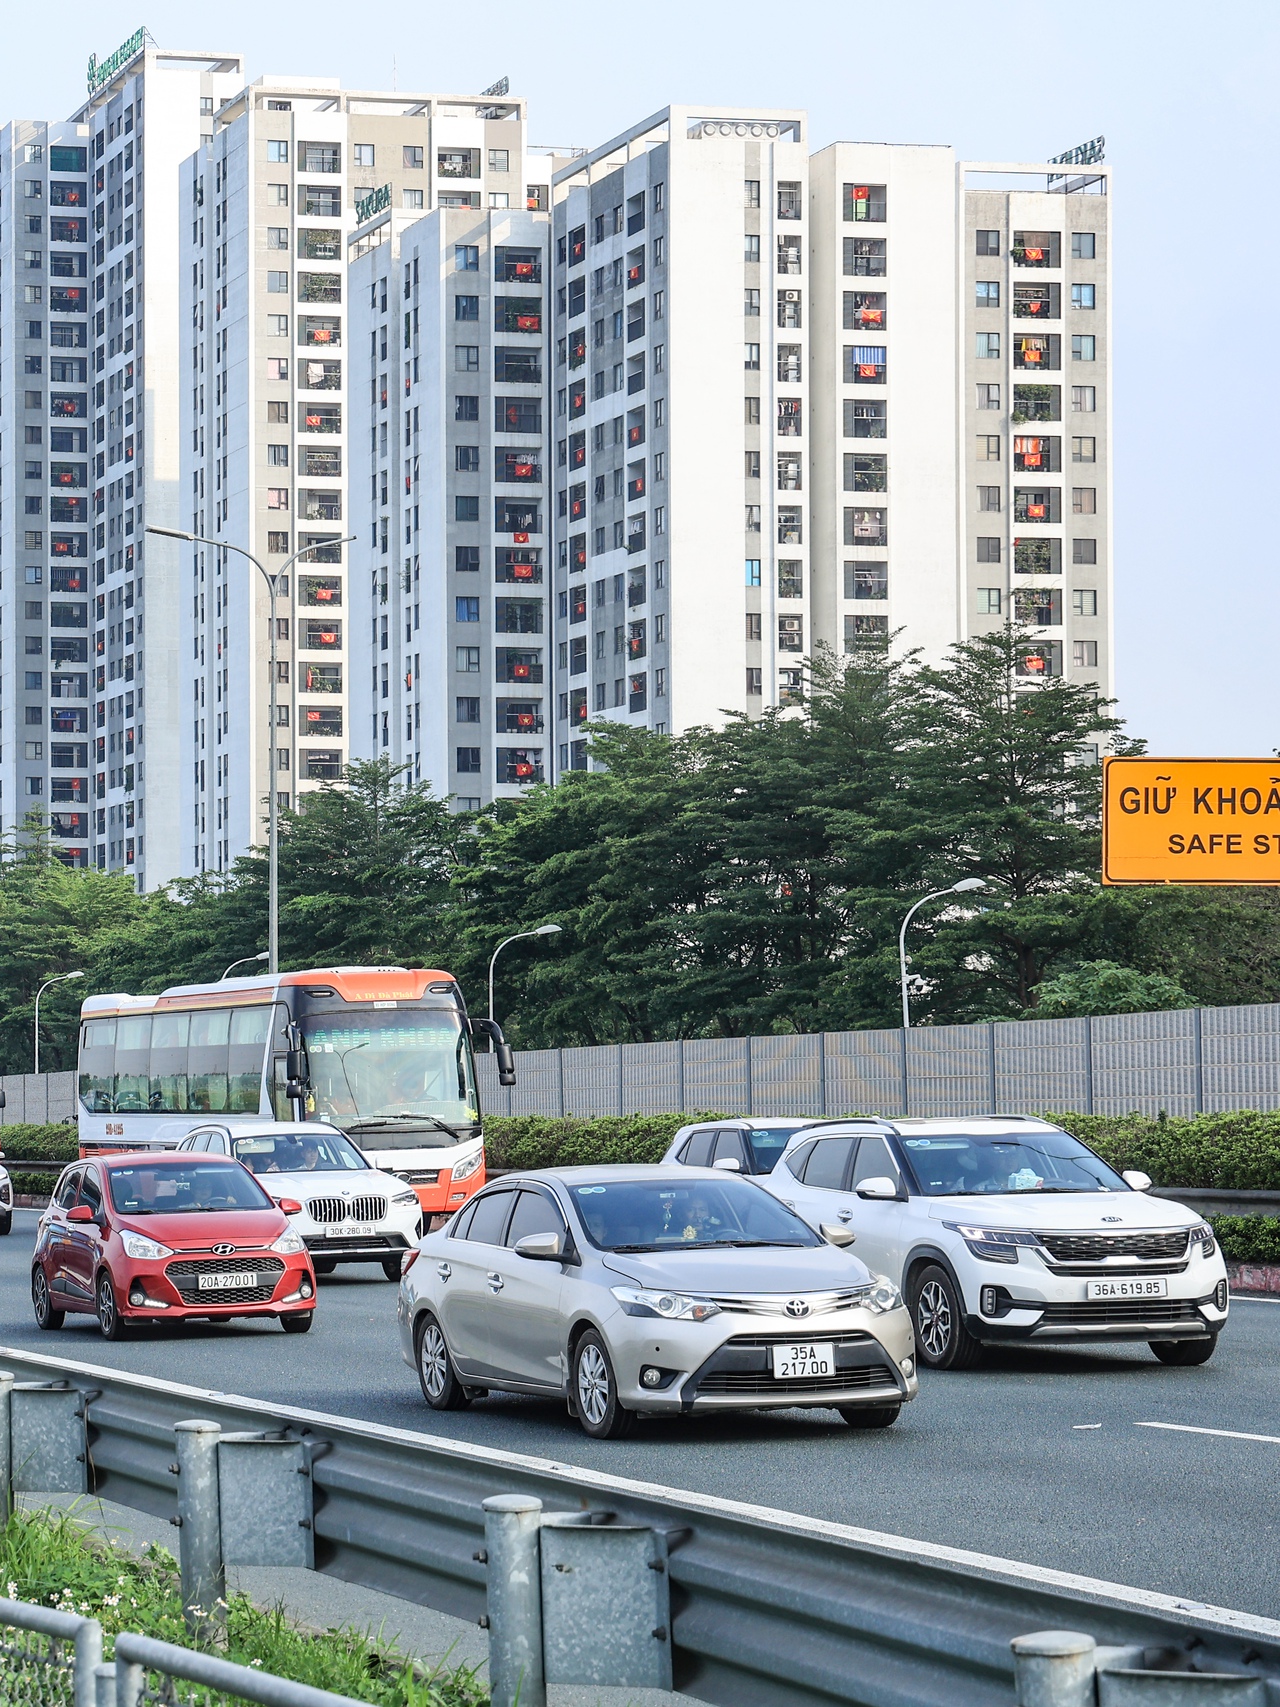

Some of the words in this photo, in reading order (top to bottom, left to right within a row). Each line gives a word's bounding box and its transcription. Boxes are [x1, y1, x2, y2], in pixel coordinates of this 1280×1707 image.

[1119, 775, 1177, 815] GIỮ
[1168, 834, 1243, 854] SAFE
[312, 1028, 371, 1047] ANH
[380, 1027, 454, 1047] KHOA
[330, 1227, 372, 1236] 30K-280.09
[201, 1274, 254, 1288] 20A-270.01
[1094, 1282, 1160, 1296] 36A-619.85
[790, 1346, 816, 1360] 35A
[781, 1361, 828, 1376] 217.00
